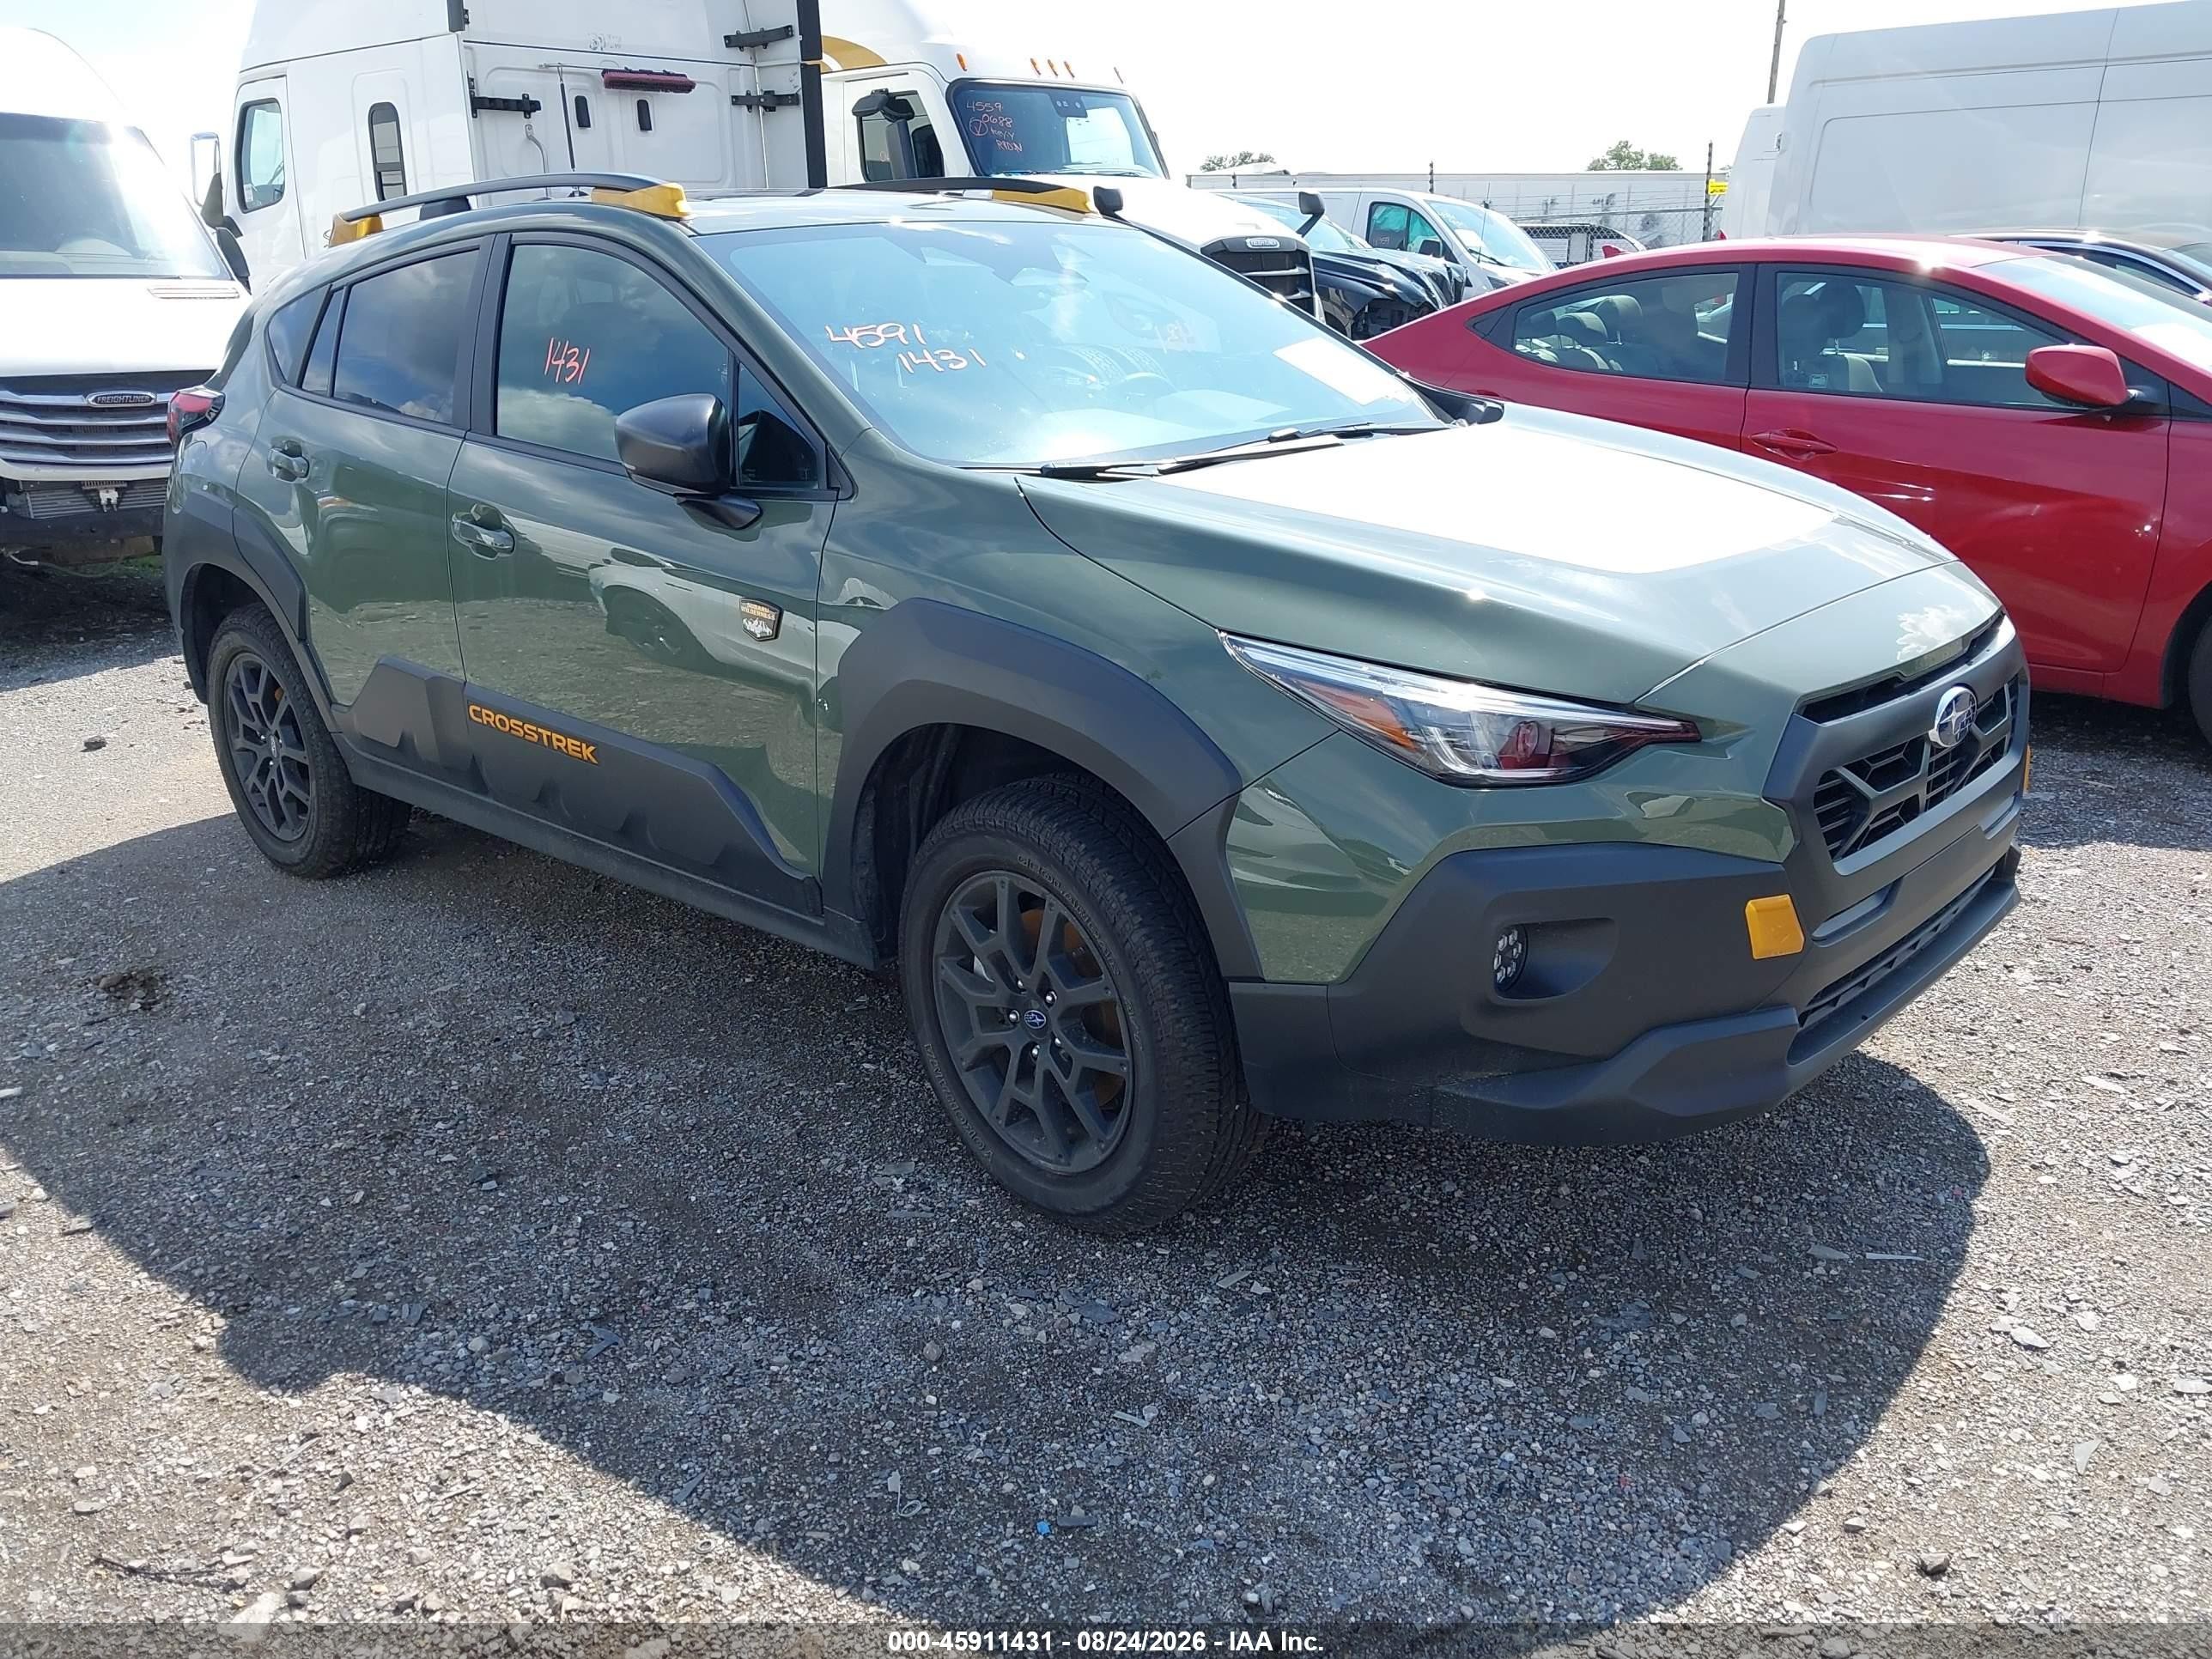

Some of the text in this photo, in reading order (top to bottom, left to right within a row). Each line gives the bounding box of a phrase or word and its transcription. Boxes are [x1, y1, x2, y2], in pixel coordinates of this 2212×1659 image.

[966, 100, 1003, 112] 4559
[981, 113, 1013, 128] 0688
[824, 322, 927, 349] 4591
[544, 337, 590, 385] 1431
[897, 348, 987, 374] 1431
[96, 395, 150, 404] FREIGHTLINER
[468, 704, 599, 765] CROSSTREK
